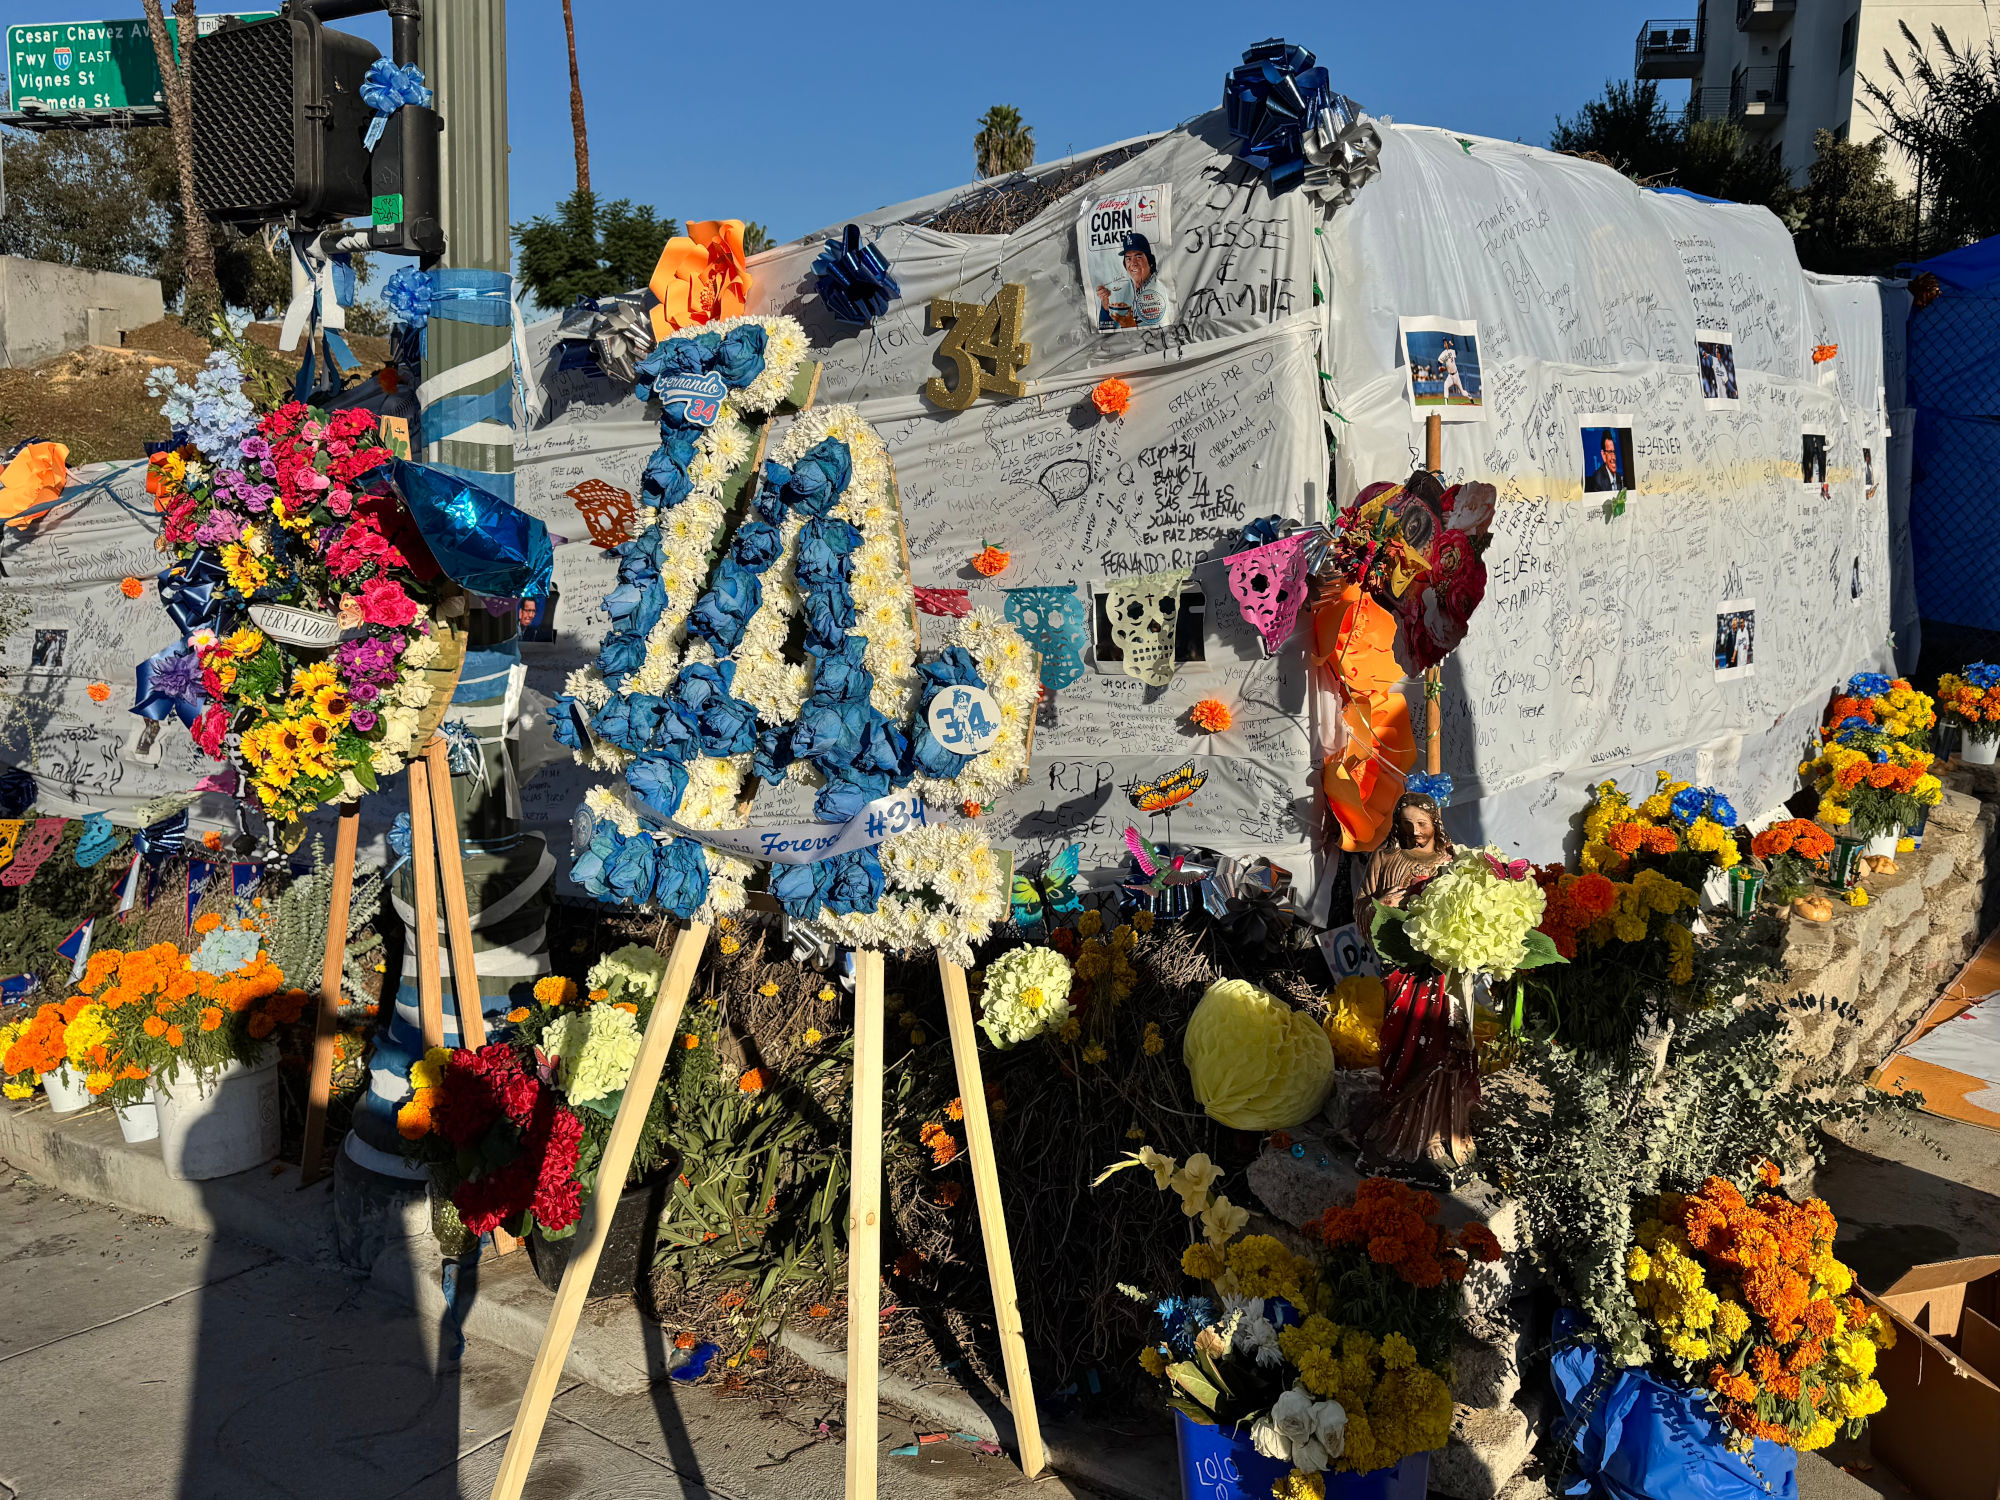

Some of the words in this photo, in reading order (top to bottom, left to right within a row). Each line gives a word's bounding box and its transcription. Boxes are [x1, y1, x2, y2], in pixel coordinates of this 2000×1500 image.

[15, 27, 58, 43] Cesar
[66, 23, 124, 40] Chavez
[16, 53, 46, 68] Fwy
[57, 54, 69, 66] 10
[79, 51, 111, 63] EAST
[18, 73, 71, 91] Vignes
[78, 71, 95, 86] St
[94, 93, 110, 107] St
[1096, 198, 1131, 212] Kellogg's
[1090, 208, 1133, 233] CORN
[1185, 218, 1290, 254] JESSE
[1502, 245, 1547, 313] 34
[1189, 278, 1296, 318] JAMIE
[926, 283, 1033, 411] 34
[1168, 376, 1217, 414] GRACIAS
[1220, 363, 1244, 388] POR
[690, 399, 717, 422] 34
[1022, 427, 1066, 449] MEJOR
[1000, 455, 1020, 471] LAS
[1045, 466, 1088, 489] MARCO
[1162, 528, 1186, 545] PAZ
[935, 701, 990, 744] 34
[1048, 761, 1115, 801] RIP
[864, 797, 927, 839] #34
